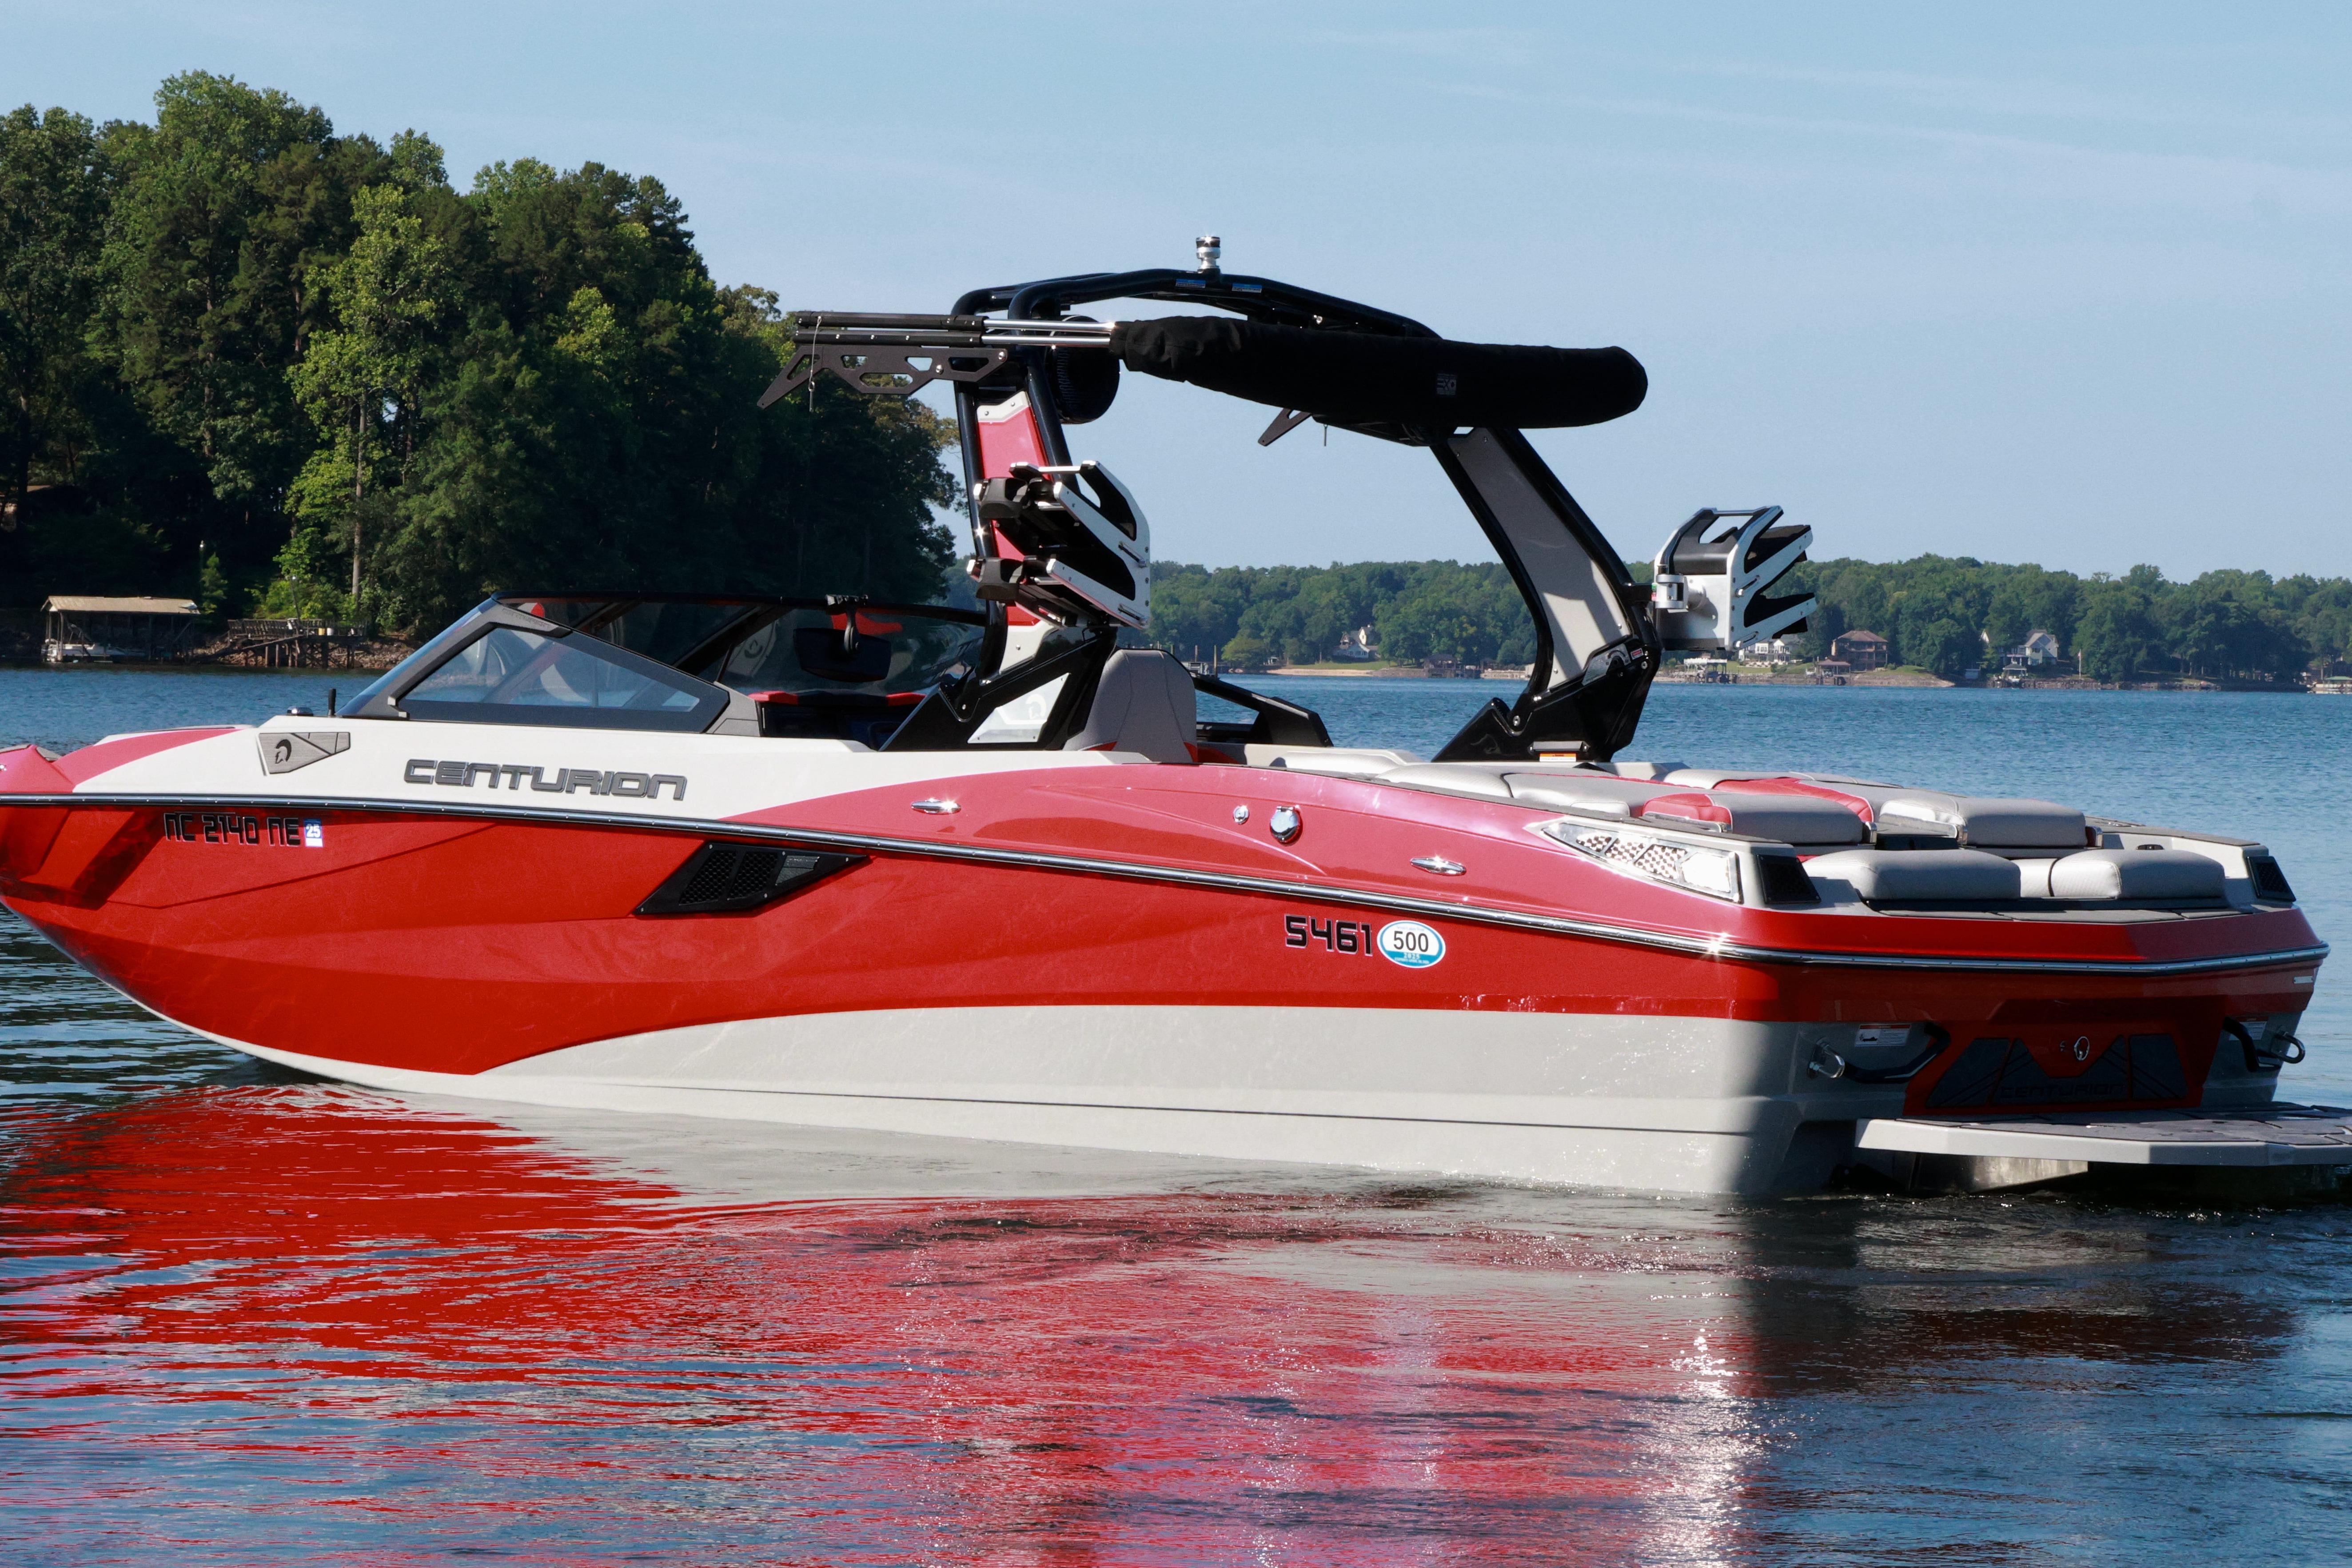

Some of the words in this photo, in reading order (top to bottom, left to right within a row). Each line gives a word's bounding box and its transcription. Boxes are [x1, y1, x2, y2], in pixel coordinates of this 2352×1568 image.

[404, 758, 687, 801] CENTURION
[164, 813, 195, 842] NC
[201, 814, 259, 845] 2140
[267, 817, 301, 847] NE
[306, 823, 321, 838] 25
[1284, 914, 1373, 957] 5461
[1393, 930, 1428, 952] 500
